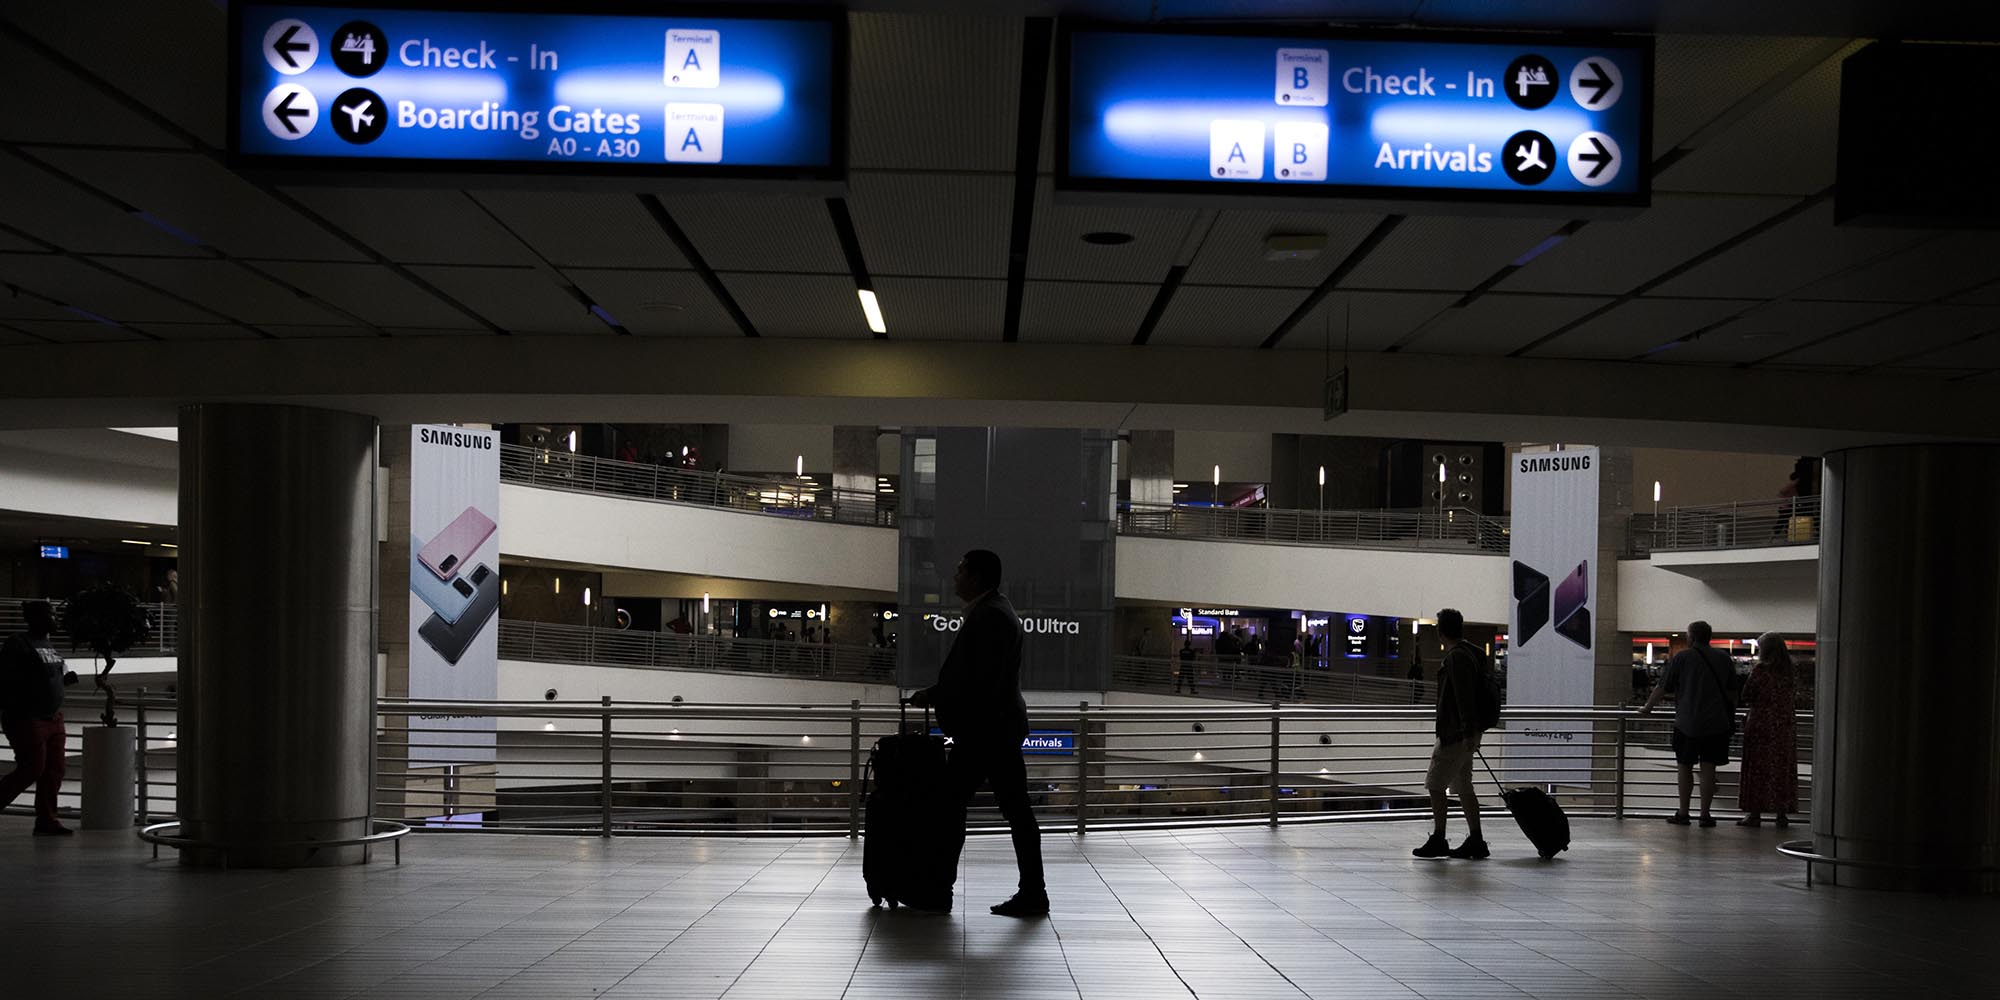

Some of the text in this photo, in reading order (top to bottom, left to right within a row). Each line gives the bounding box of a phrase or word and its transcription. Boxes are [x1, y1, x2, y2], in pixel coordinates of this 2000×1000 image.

[671, 34, 713, 44] Terminal
[399, 39, 497, 70] Check
[530, 43, 559, 71] In
[682, 48, 702, 71] A
[1282, 53, 1322, 64] Terminal
[1293, 66, 1309, 90] B
[1342, 66, 1436, 96] Check
[1467, 71, 1495, 98] In
[398, 100, 642, 140] Boarding Gates
[546, 137, 577, 156] A0
[596, 138, 641, 158] A30
[681, 127, 703, 152] A
[1227, 141, 1308, 165] A B
[1374, 142, 1493, 173] Arrivals
[421, 428, 492, 450] SAMSUNG
[1520, 455, 1590, 473] SAMSUNG
[1036, 617, 1080, 635] Ultra
[1022, 737, 1063, 748] Arrivals
